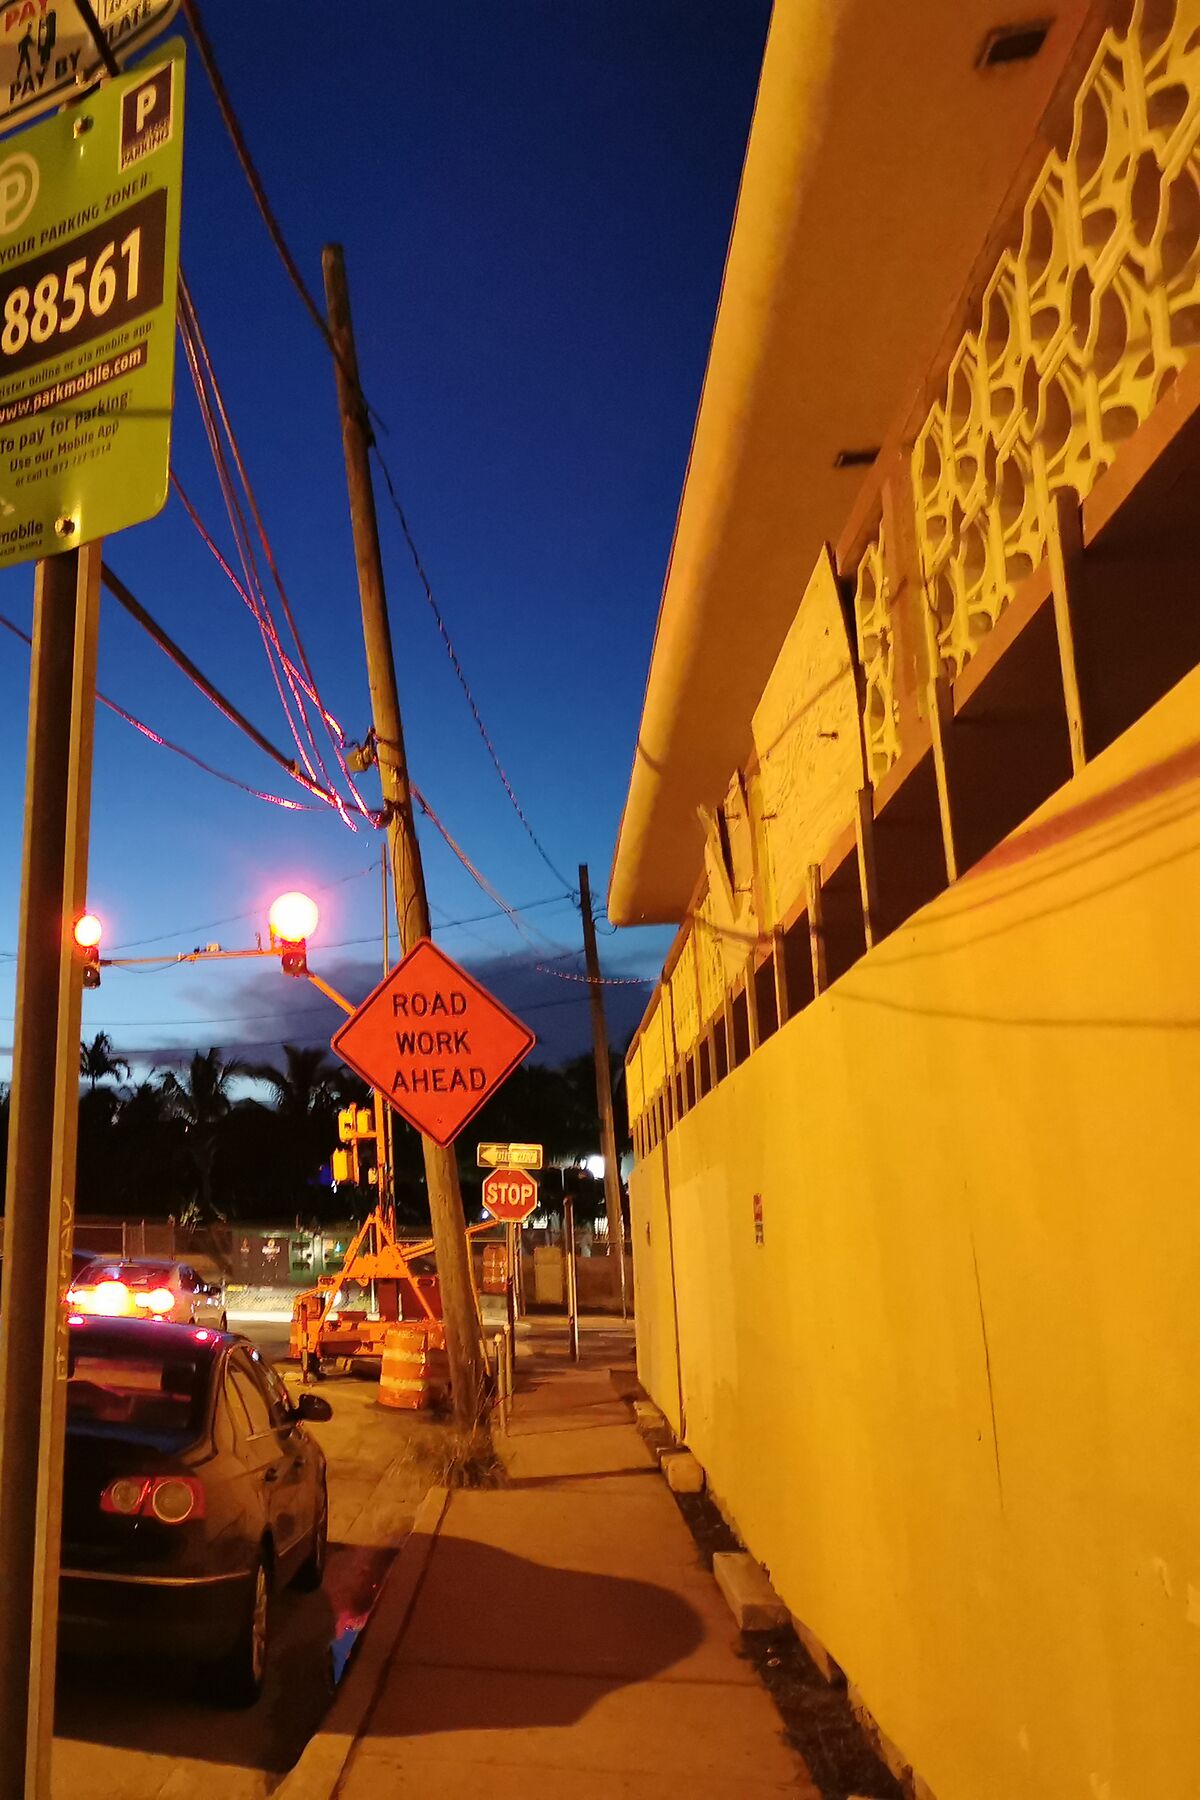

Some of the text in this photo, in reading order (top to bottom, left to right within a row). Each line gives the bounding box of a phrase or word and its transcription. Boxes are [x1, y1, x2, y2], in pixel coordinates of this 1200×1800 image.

[9, 70, 47, 104] PAY
[54, 49, 81, 80] BY
[136, 84, 157, 133] P
[40, 203, 100, 249] PARKING
[1, 226, 141, 355] 88561
[29, 367, 61, 388] online
[64, 361, 74, 372] or
[78, 351, 94, 366] via
[96, 333, 130, 360] mobile
[0, 437, 15, 455] To
[19, 429, 44, 450] pay
[50, 414, 73, 436] for
[9, 420, 119, 472] Use our Mobile App
[392, 992, 468, 1017] ROAD
[395, 1030, 471, 1056] WORK
[391, 1067, 487, 1094] AHEAD
[486, 1182, 534, 1206] STOP
